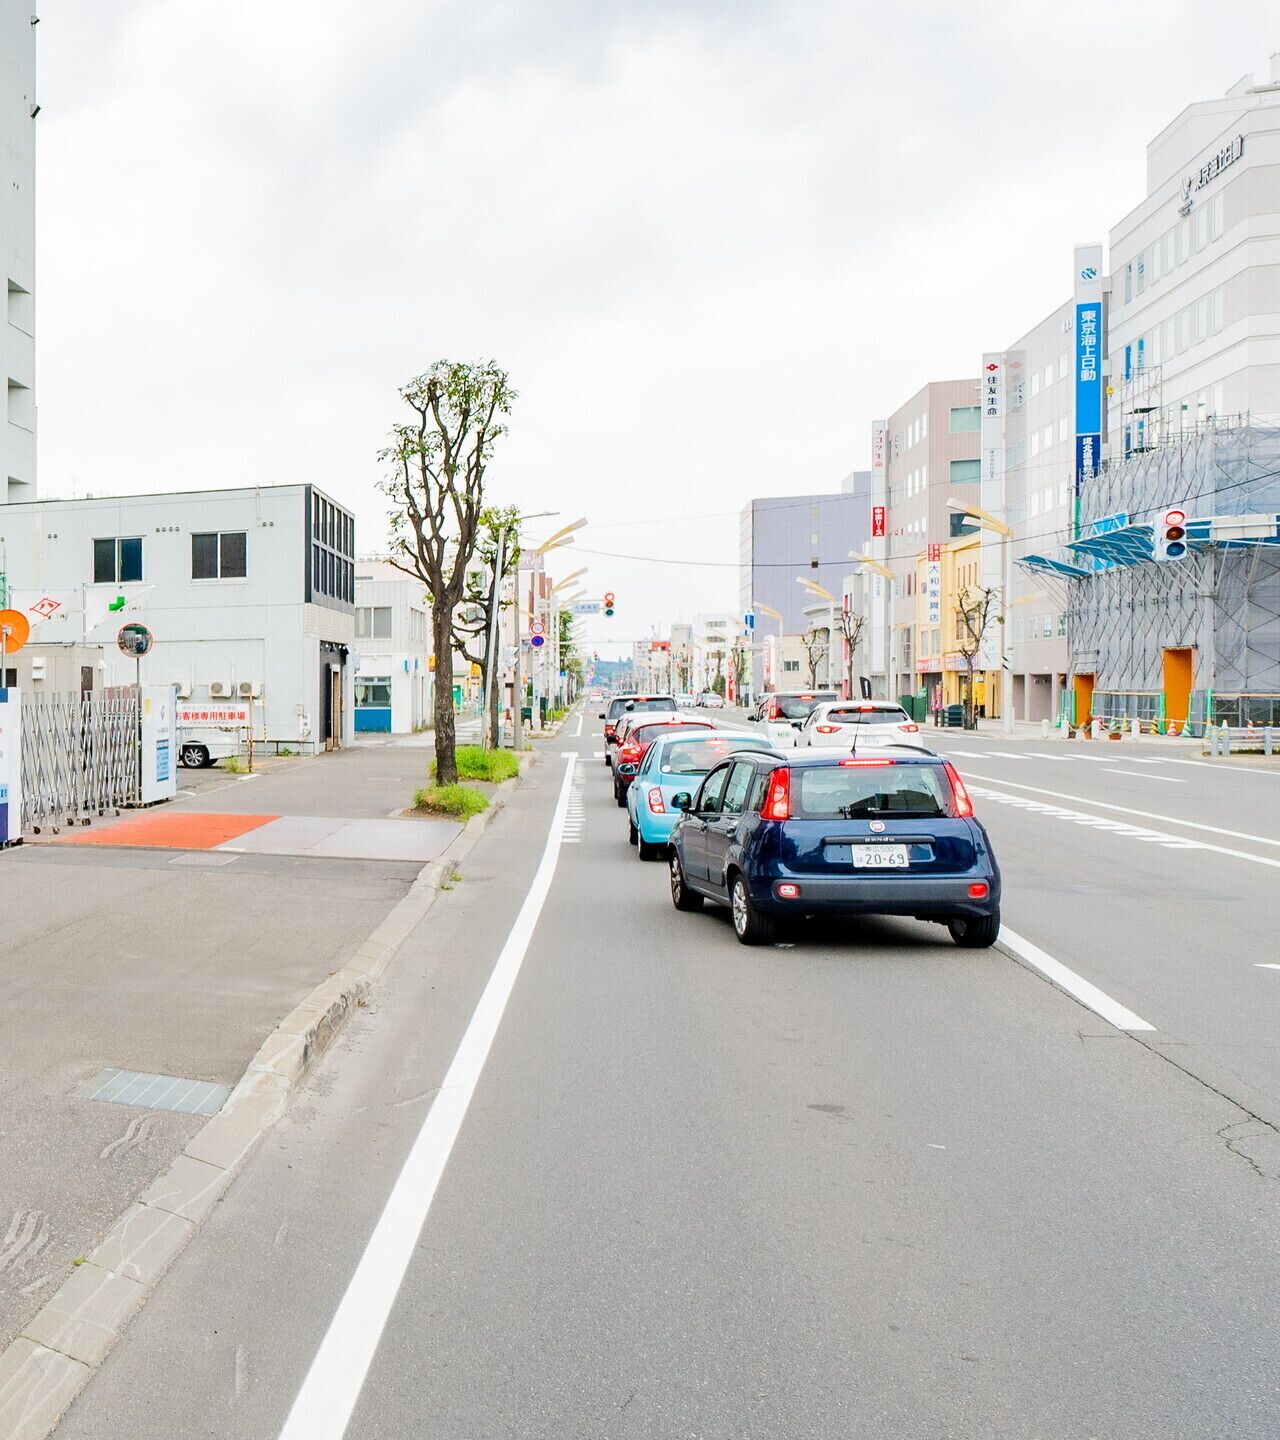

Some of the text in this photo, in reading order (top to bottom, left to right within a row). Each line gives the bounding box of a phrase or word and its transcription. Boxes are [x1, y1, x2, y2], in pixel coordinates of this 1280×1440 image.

[1081, 310, 1097, 381] 東京海上日動
[987, 376, 998, 416] 住友生命
[865, 853, 905, 864] 20-69
